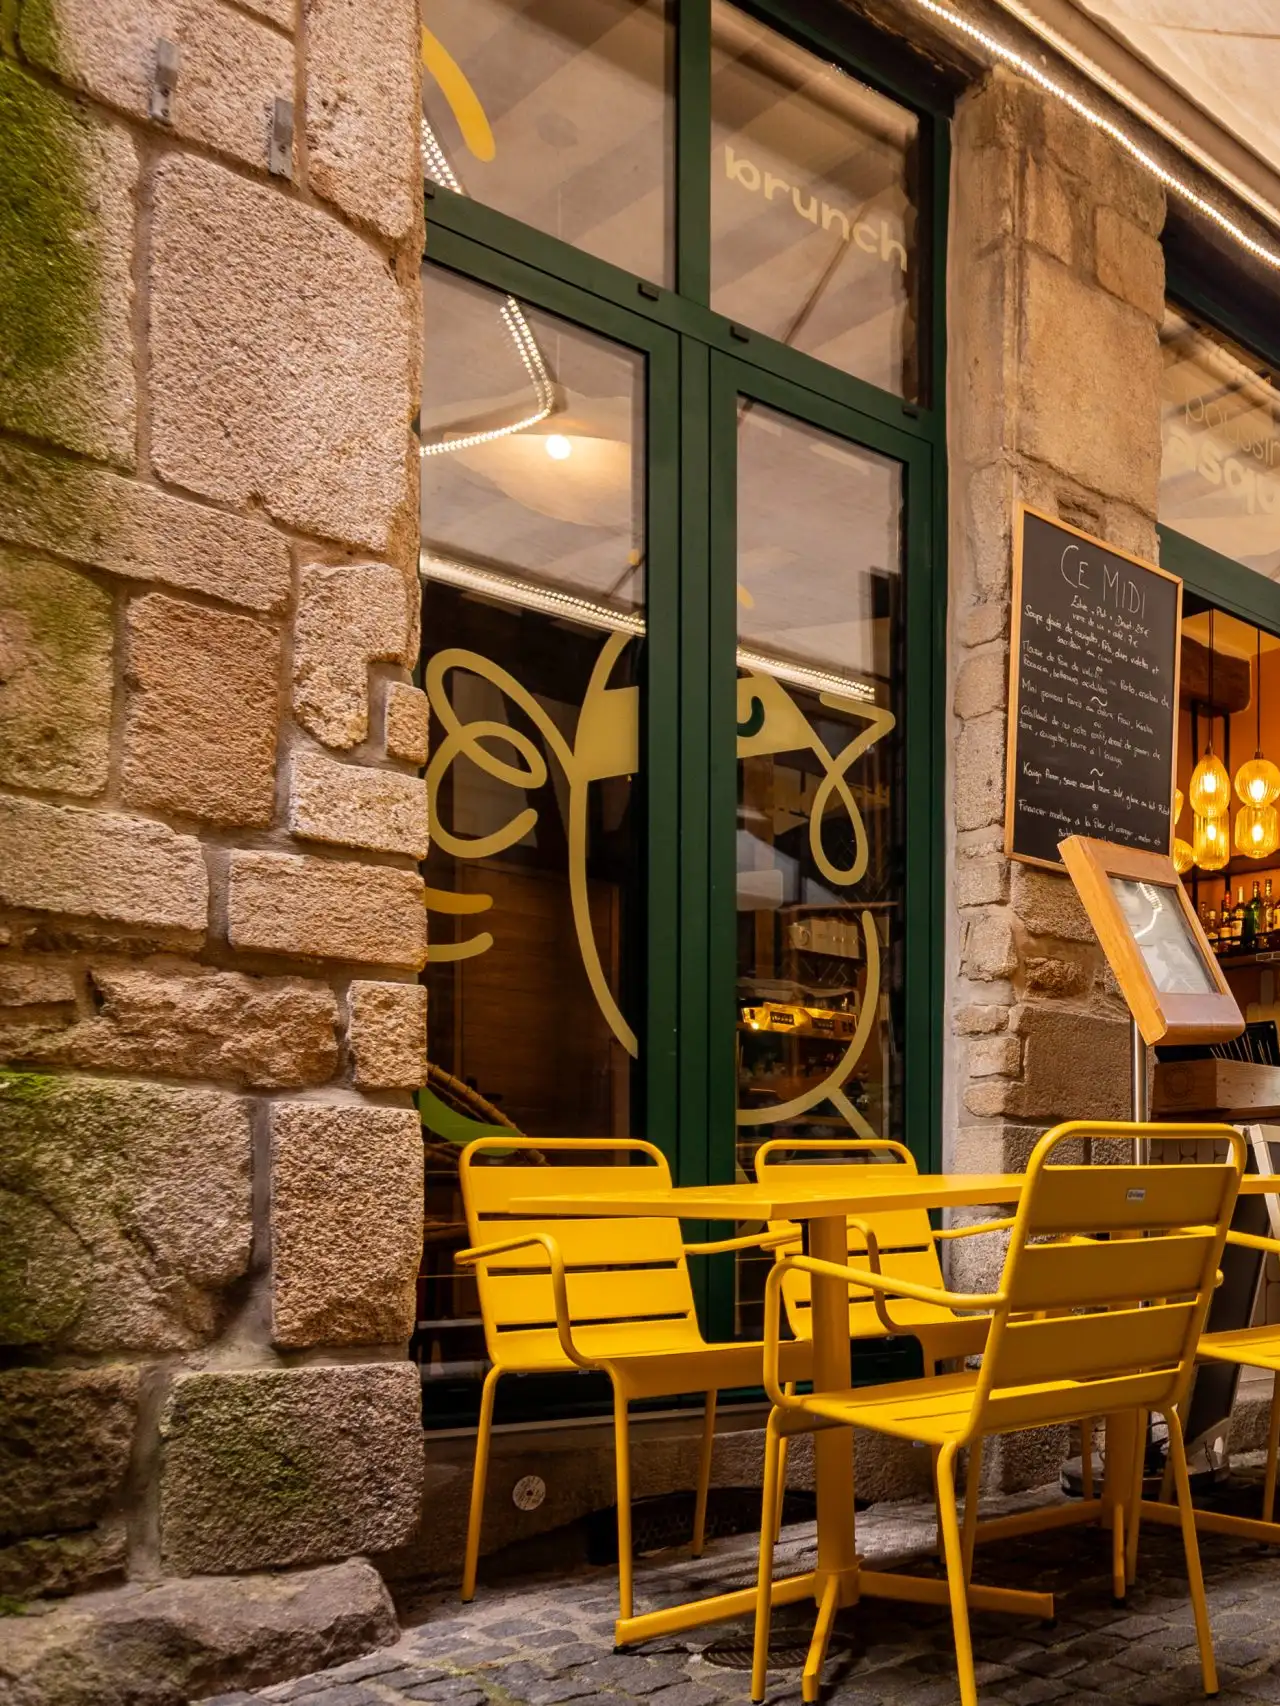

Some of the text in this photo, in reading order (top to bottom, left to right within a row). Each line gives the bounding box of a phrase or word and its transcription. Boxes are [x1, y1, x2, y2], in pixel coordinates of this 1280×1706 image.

[725, 144, 908, 272] brunch
[1061, 544, 1145, 619] CE MIDI
[1024, 604, 1043, 624] Soupe
[1065, 622, 1073, 634] de
[1046, 652, 1055, 662] de
[1022, 677, 1037, 693] Mini
[1051, 715, 1059, 725] de
